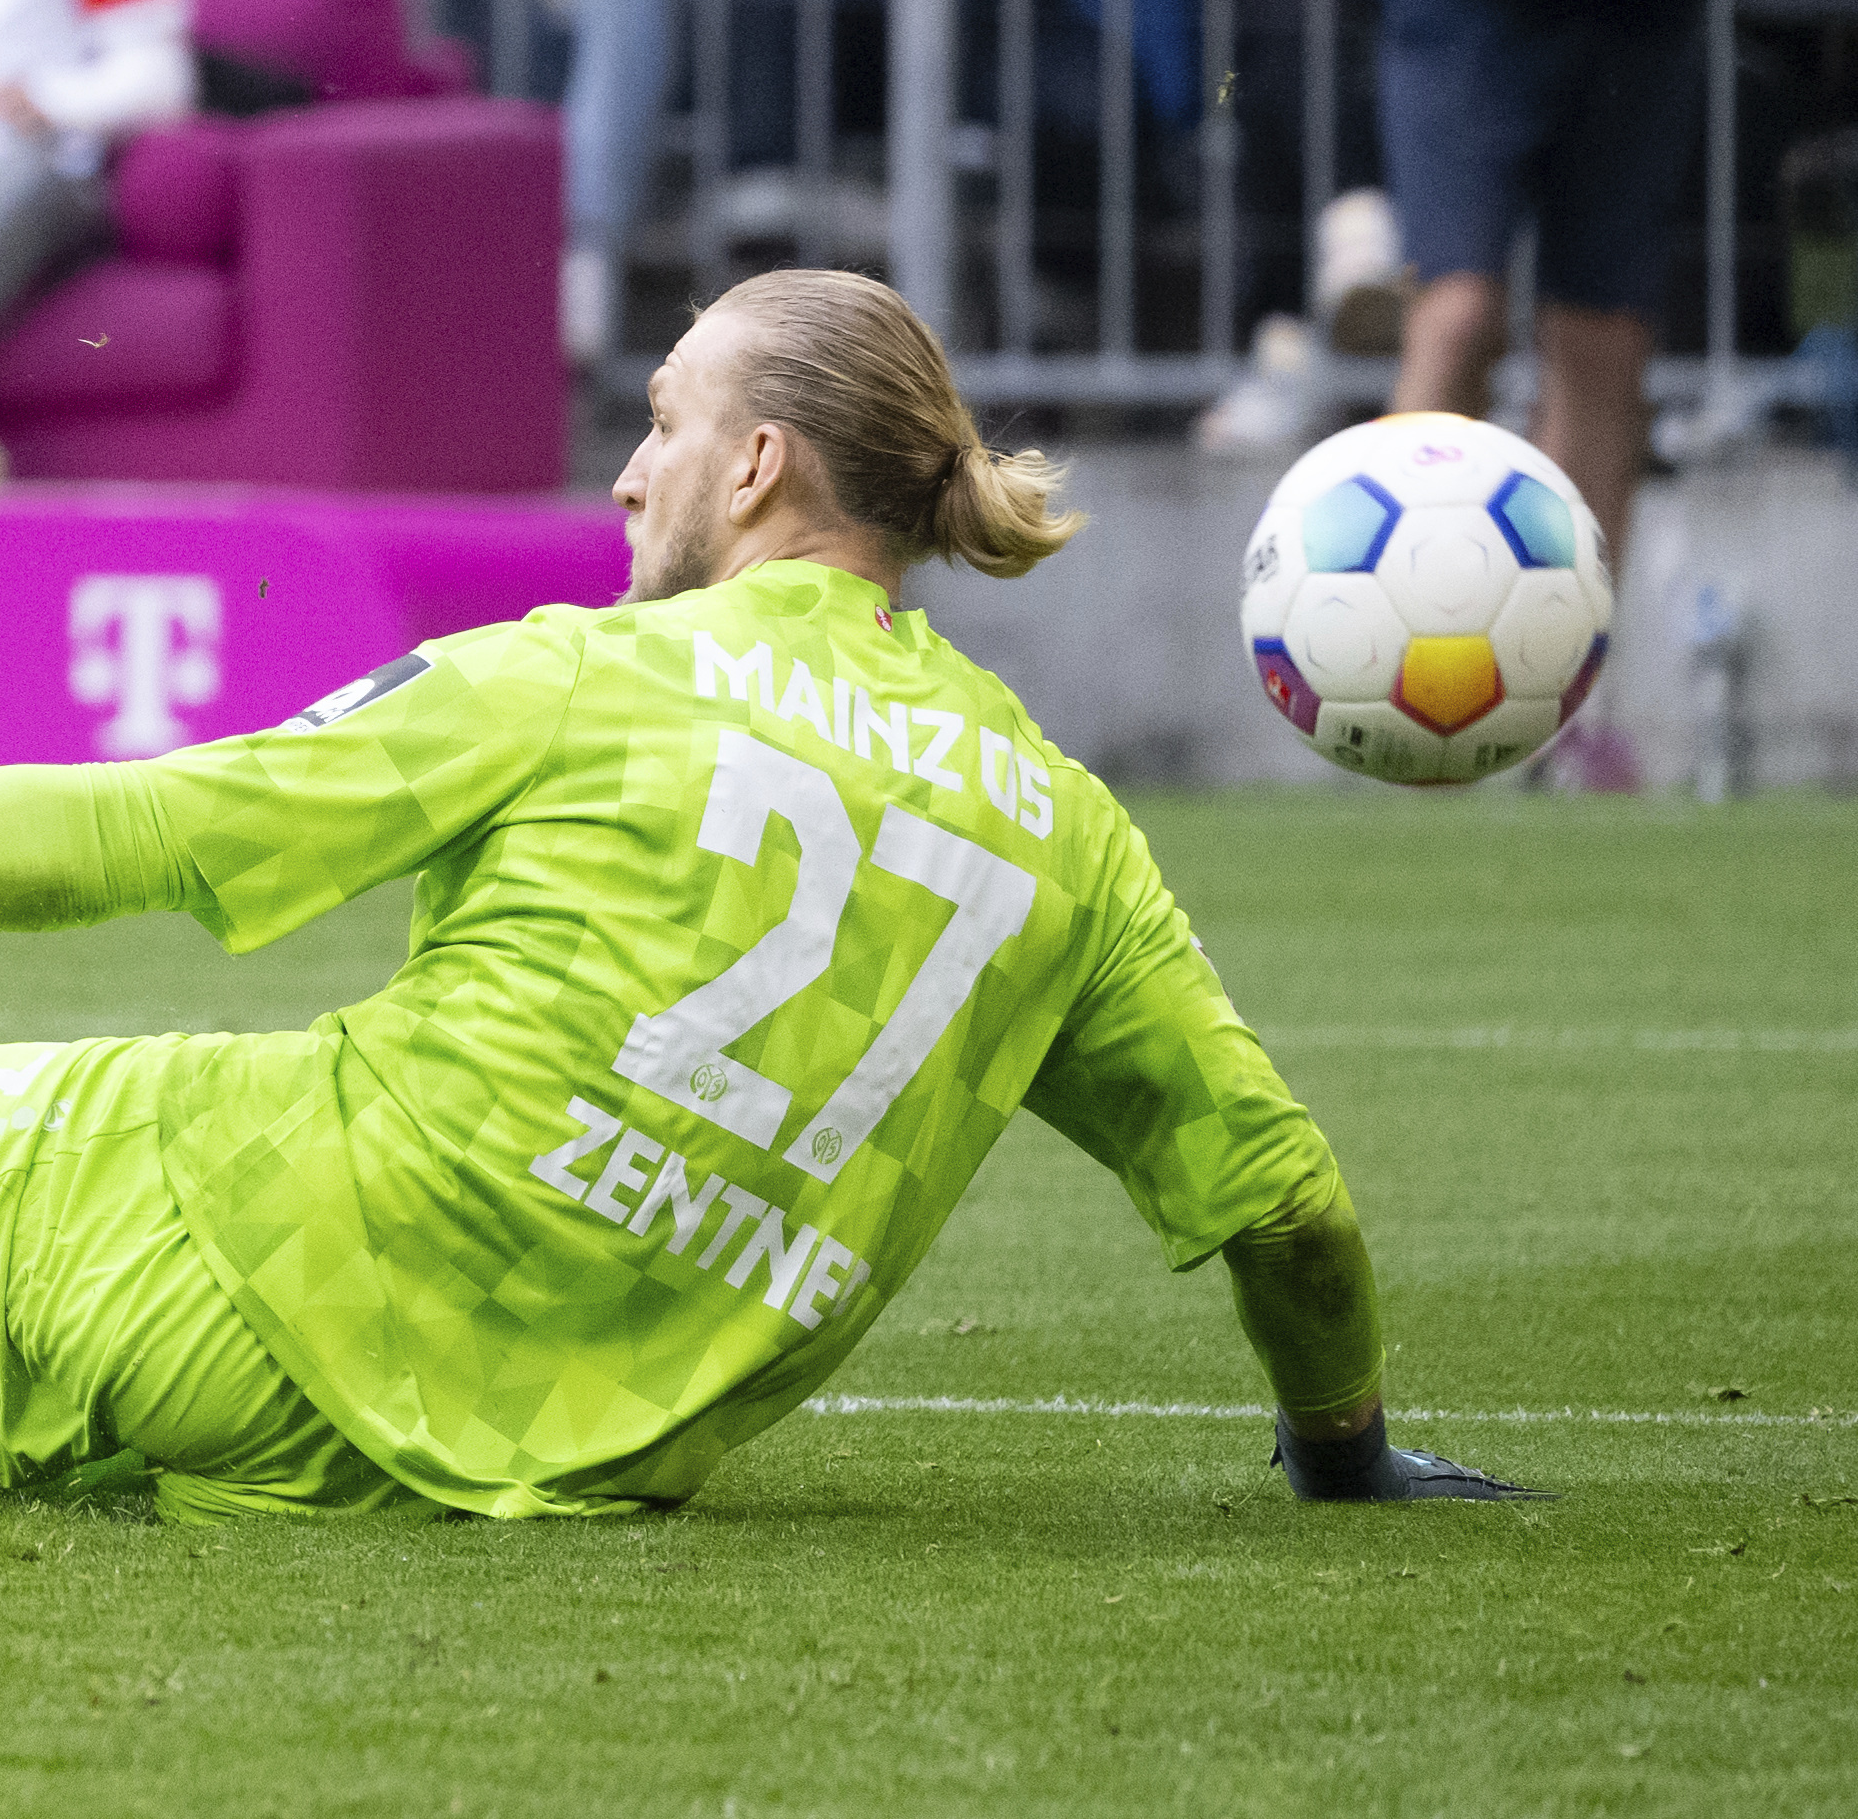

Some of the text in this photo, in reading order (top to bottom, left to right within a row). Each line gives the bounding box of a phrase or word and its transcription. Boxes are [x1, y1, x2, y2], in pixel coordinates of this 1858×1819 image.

[692, 630, 1054, 841] MAINZ 05
[610, 729, 1036, 1184] 27
